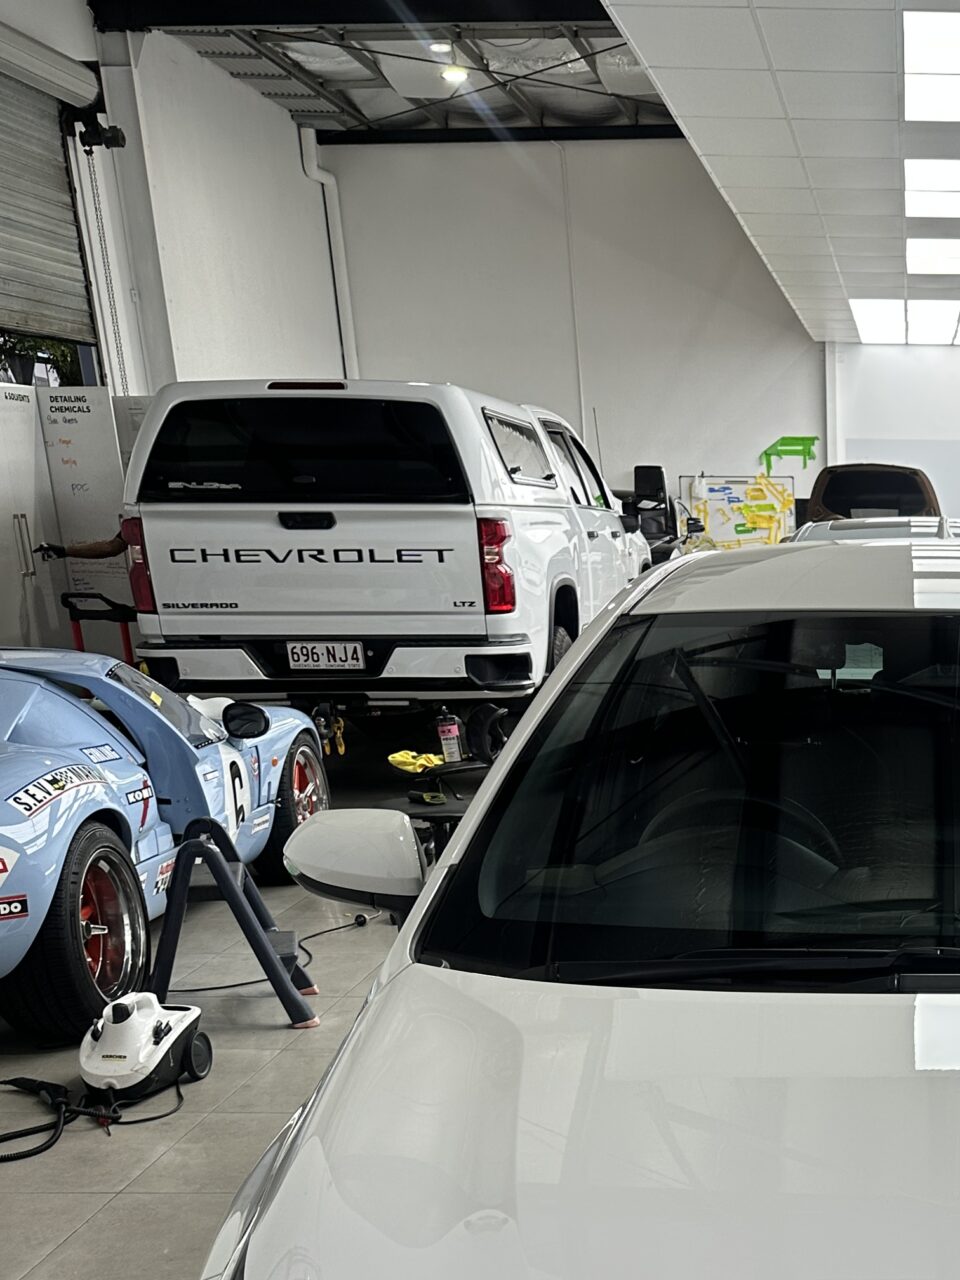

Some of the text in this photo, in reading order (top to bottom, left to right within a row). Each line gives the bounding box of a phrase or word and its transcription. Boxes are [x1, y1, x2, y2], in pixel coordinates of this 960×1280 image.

[49, 395, 87, 403] DETAILING
[49, 405, 91, 413] CHEMICALS
[169, 548, 454, 563] CHEVROLET
[127, 789, 153, 804] KONI
